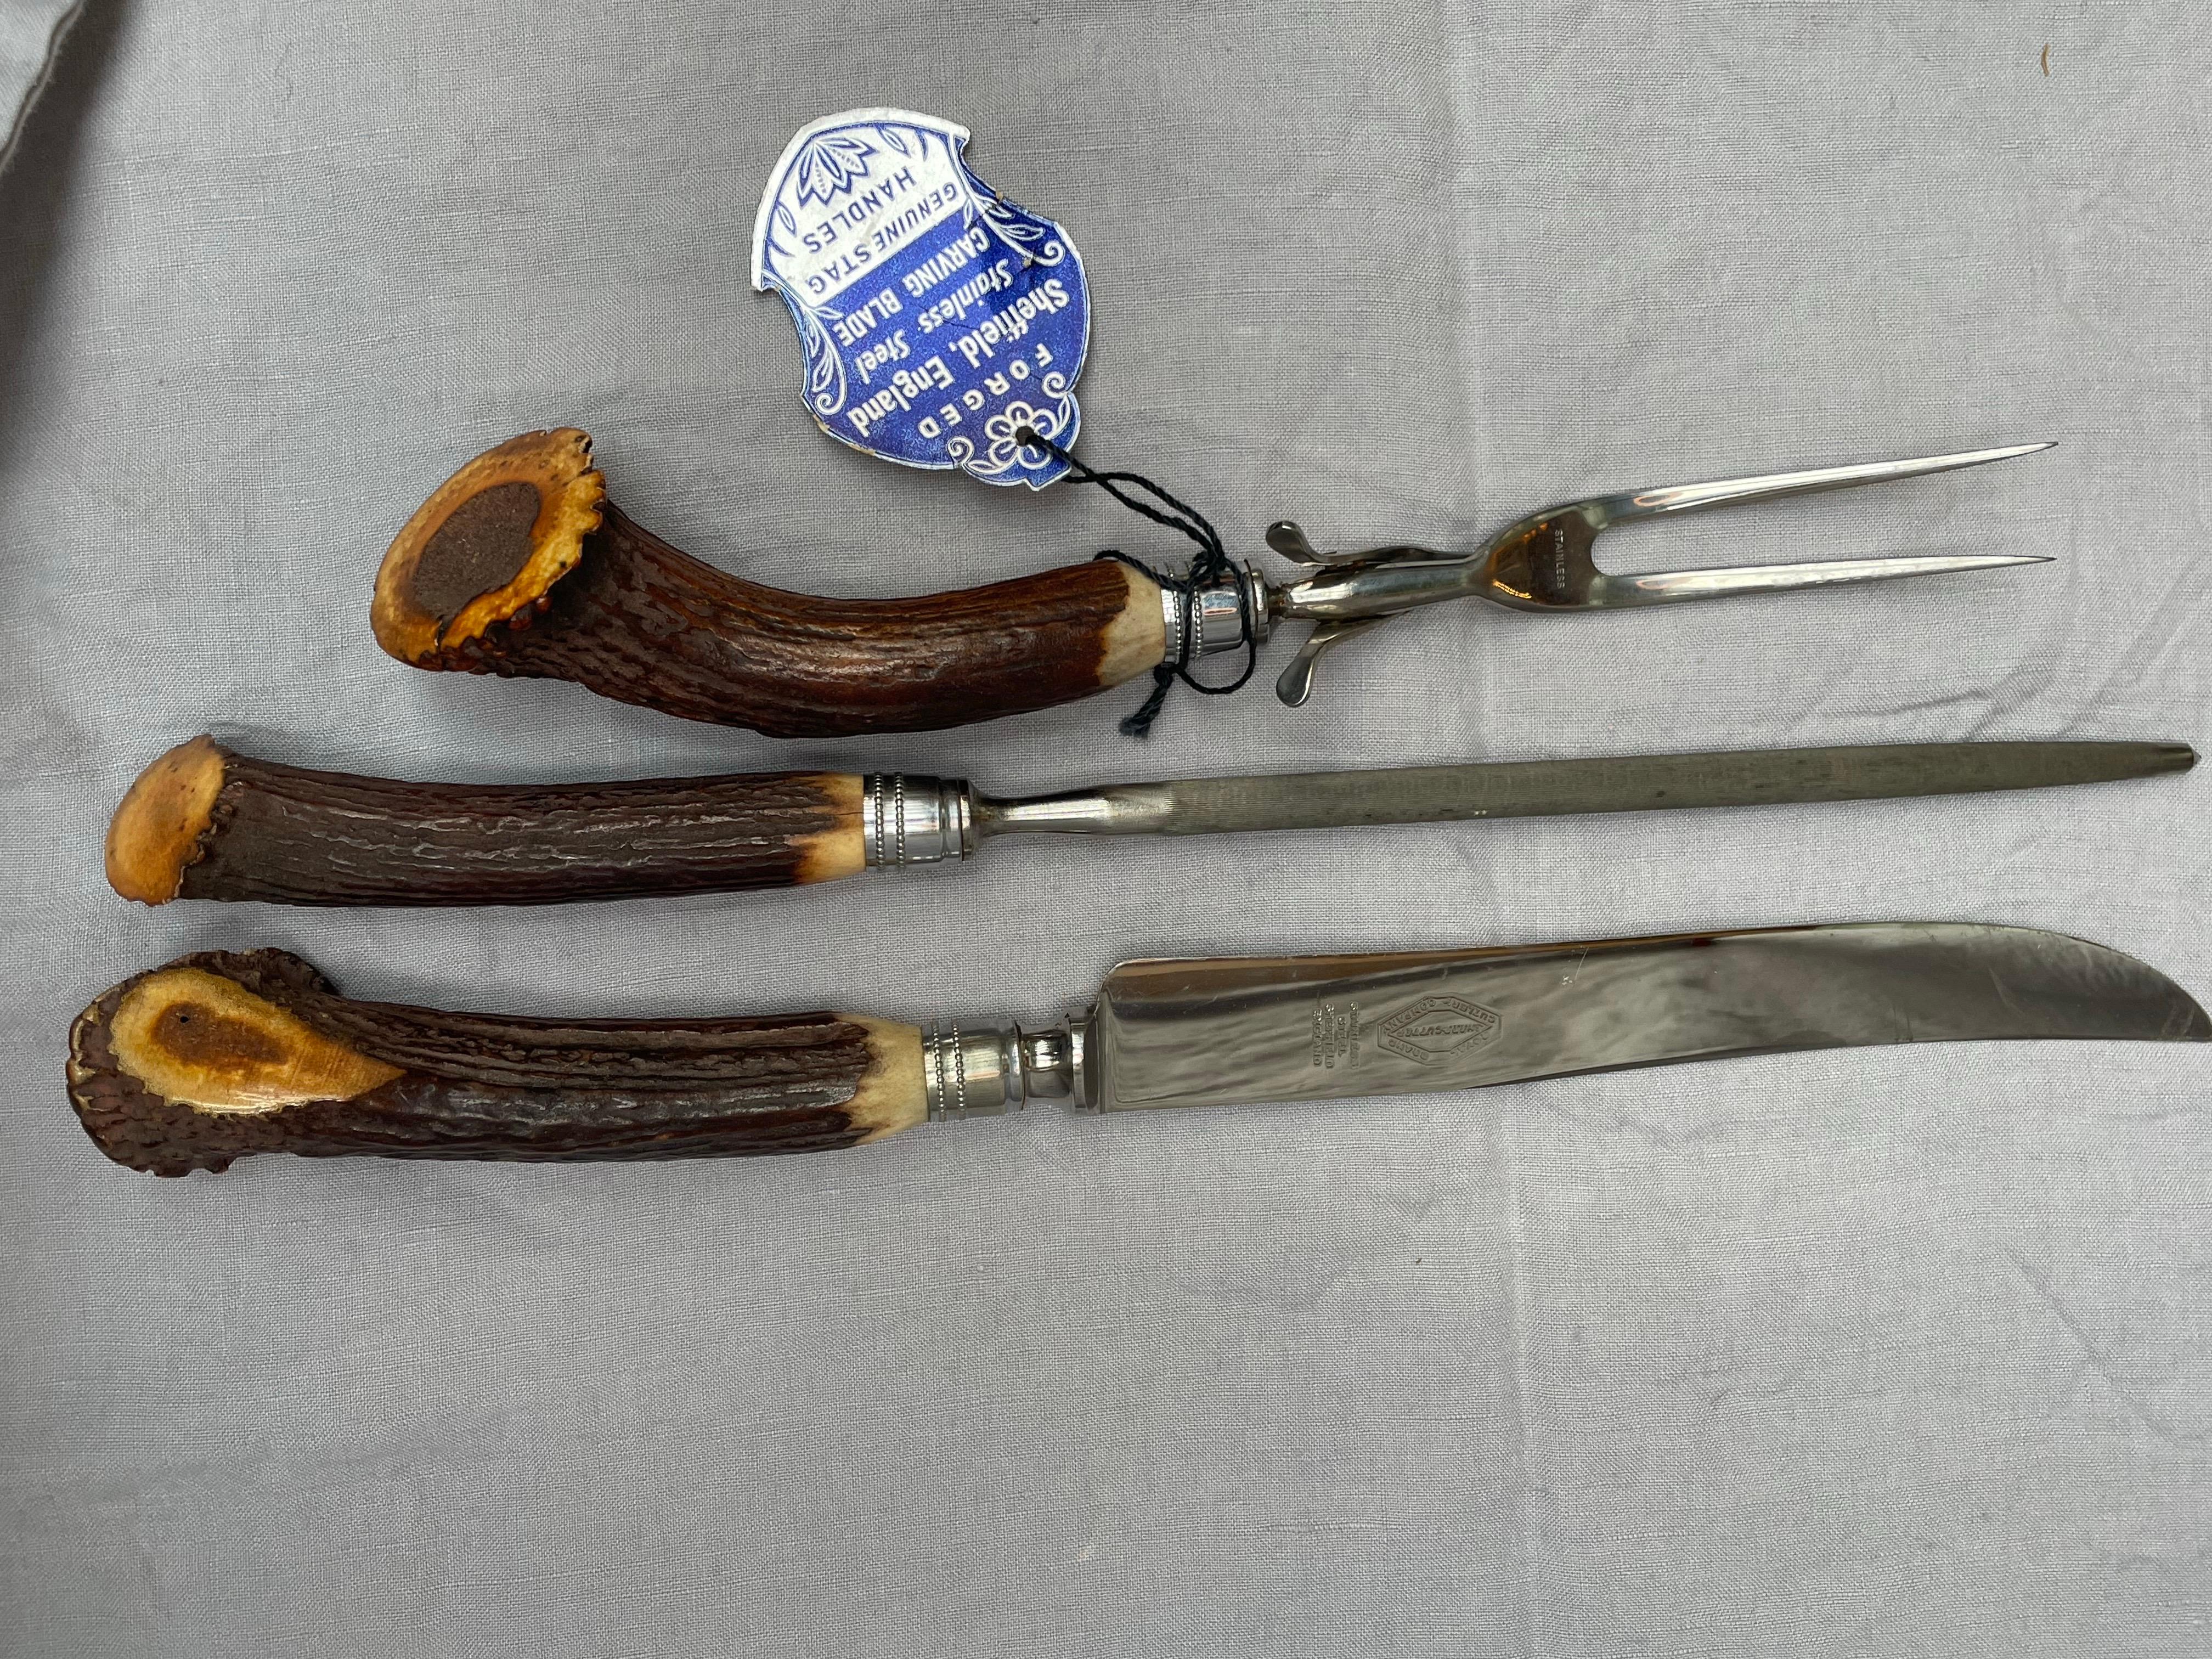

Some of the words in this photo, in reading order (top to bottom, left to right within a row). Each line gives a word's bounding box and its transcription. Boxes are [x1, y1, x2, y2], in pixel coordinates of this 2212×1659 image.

[804, 166, 917, 253] HANDLES
[878, 182, 958, 252] GENUINE
[808, 243, 871, 295] STAG
[902, 227, 990, 298] CARVING
[920, 258, 1013, 334] Stainless
[833, 287, 903, 347] BLADE
[949, 279, 1070, 368] Sheffield,
[855, 330, 911, 384] Steel
[918, 343, 1053, 439] FORGED
[847, 355, 955, 437] England
[1555, 529, 1565, 589] STAINLESS
[1312, 1009, 1322, 1066] ENGLAND
